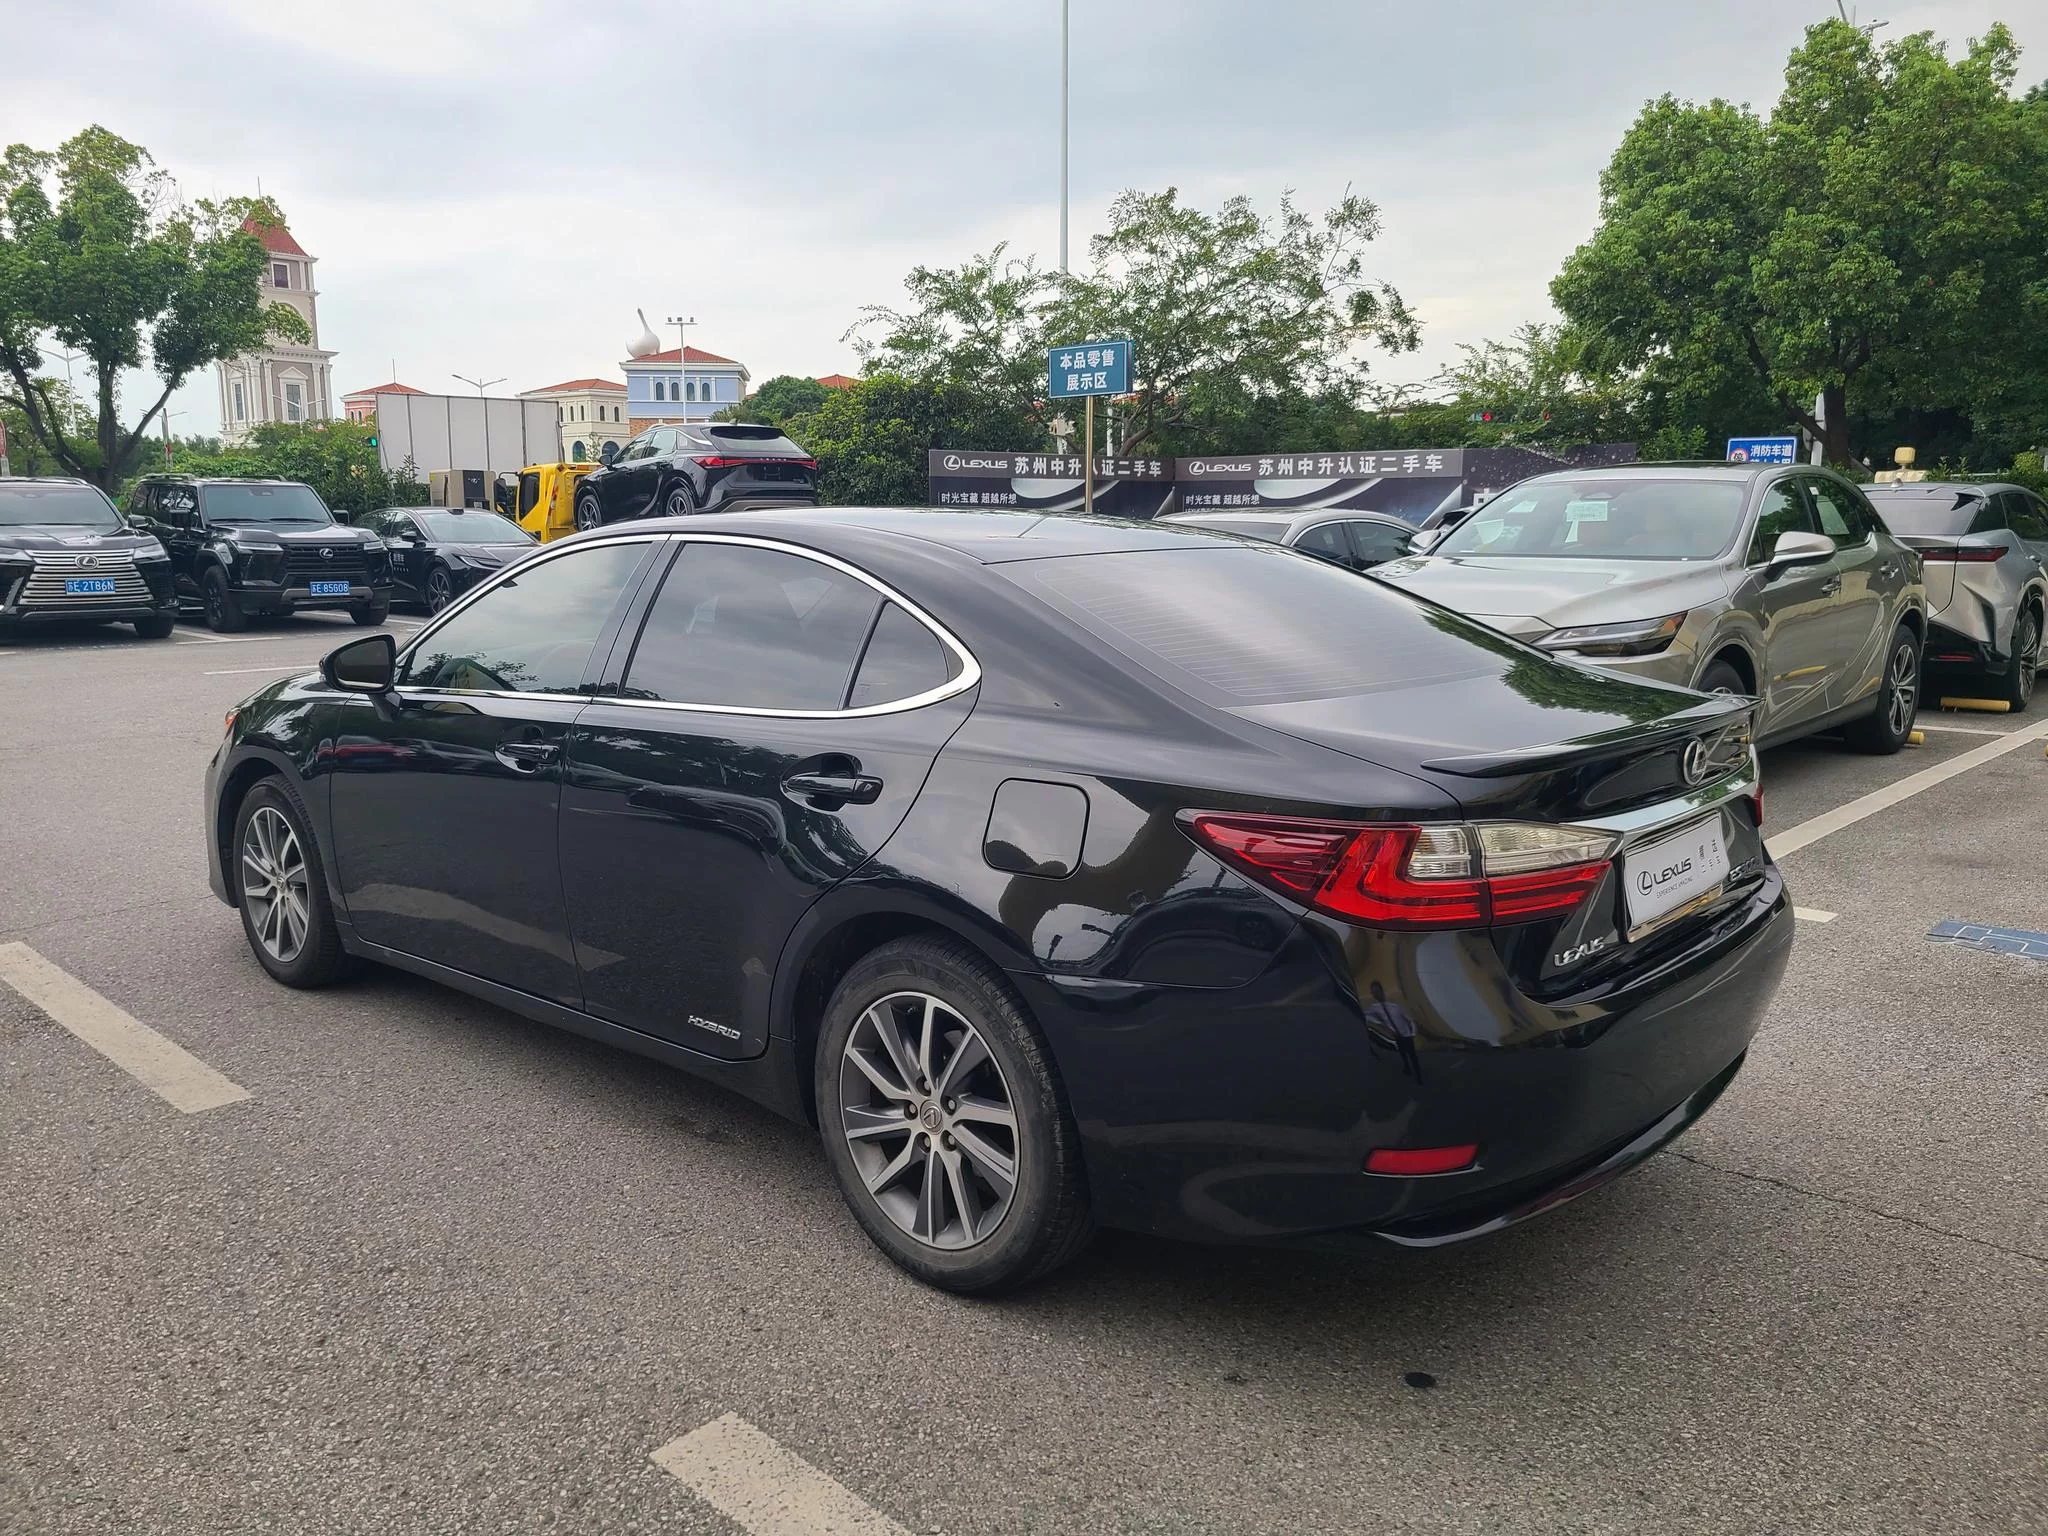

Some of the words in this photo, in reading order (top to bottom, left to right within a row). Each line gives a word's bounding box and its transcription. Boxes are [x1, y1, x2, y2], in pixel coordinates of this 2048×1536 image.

[1060, 348, 1115, 371] 本品零售
[1066, 371, 1107, 391] 展示区
[1750, 444, 1793, 457] 消防车道
[962, 459, 1008, 469] LEXUS
[1206, 463, 1252, 472] LEXUS
[1258, 453, 1444, 476] 苏州中升认证二手车
[941, 491, 978, 504] 时光宝藏
[981, 492, 1017, 504] 超越所想
[1185, 494, 1220, 505] 时光宝藏
[1223, 494, 1260, 505] 超越所想
[1653, 857, 1692, 884] LEXUS
[1554, 936, 1605, 966] LEXUS
[688, 1015, 741, 1040] HYBRID
